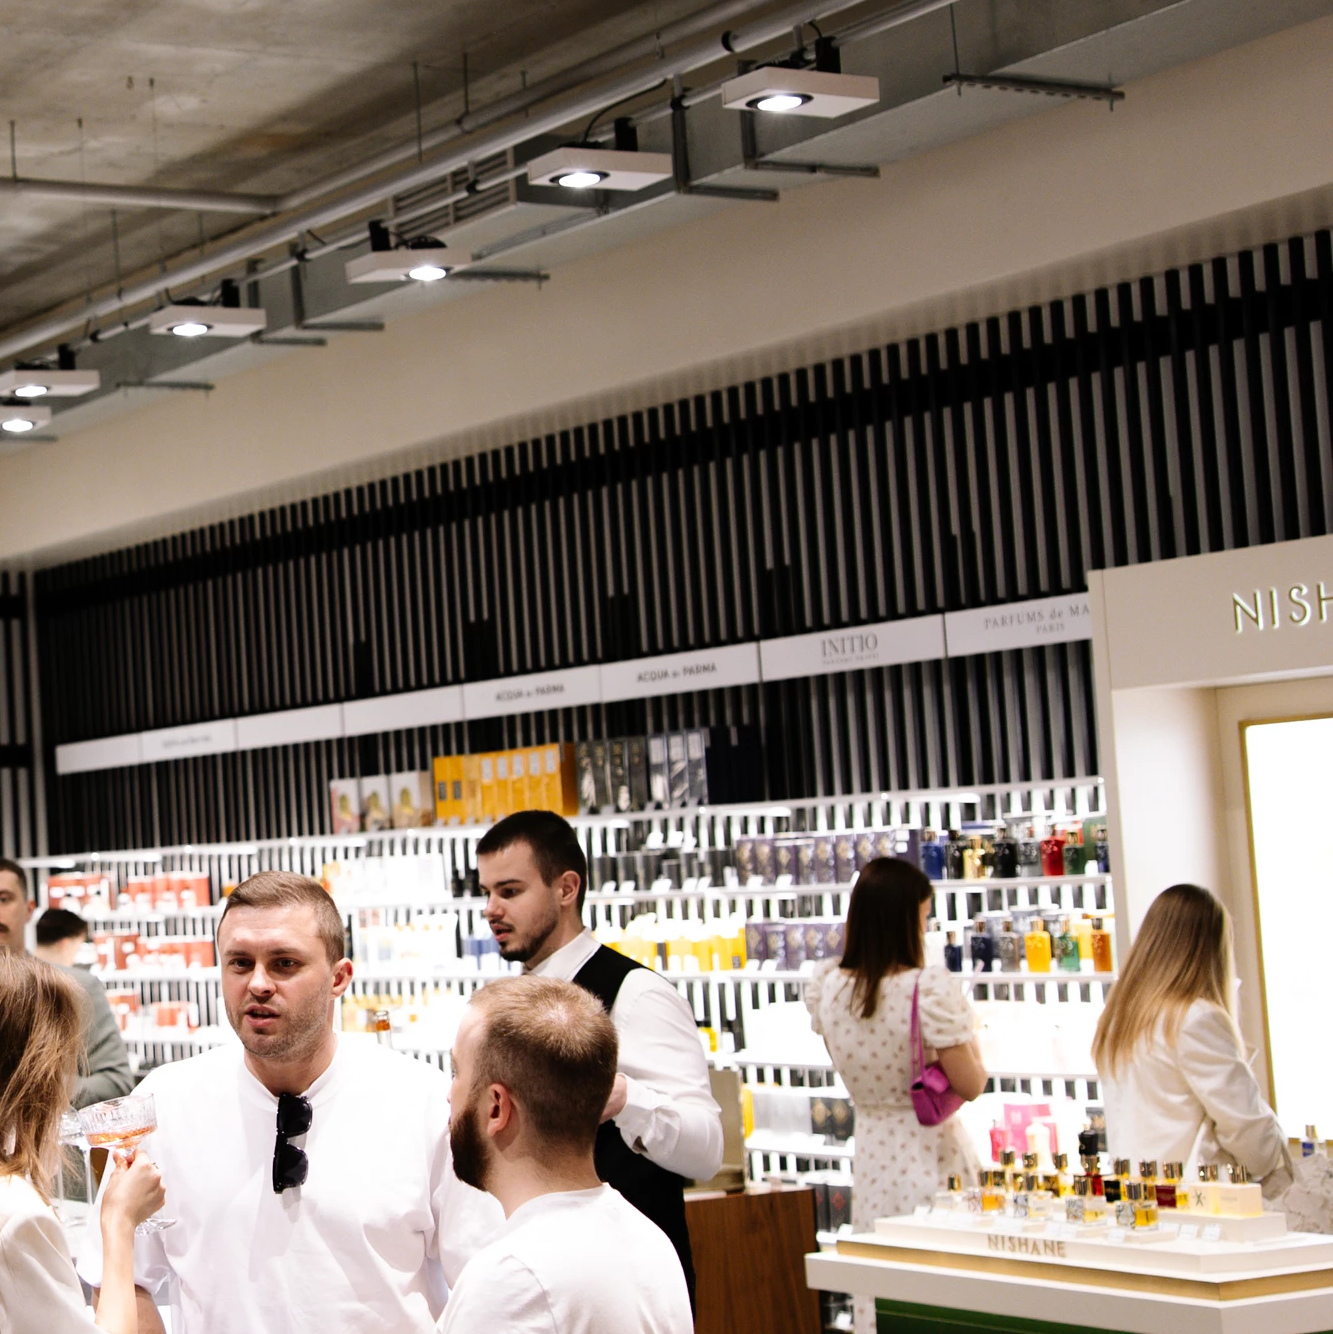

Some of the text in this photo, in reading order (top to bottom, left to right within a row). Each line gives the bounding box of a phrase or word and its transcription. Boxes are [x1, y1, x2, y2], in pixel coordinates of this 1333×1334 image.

[985, 611, 1044, 629] PARFUMS
[1050, 607, 1063, 621] de
[1036, 623, 1065, 634] PARIS
[821, 632, 878, 657] INITIO
[637, 670, 669, 683] ACQUA
[683, 663, 717, 677] PARMA
[987, 1233, 1066, 1258] NISHANE
